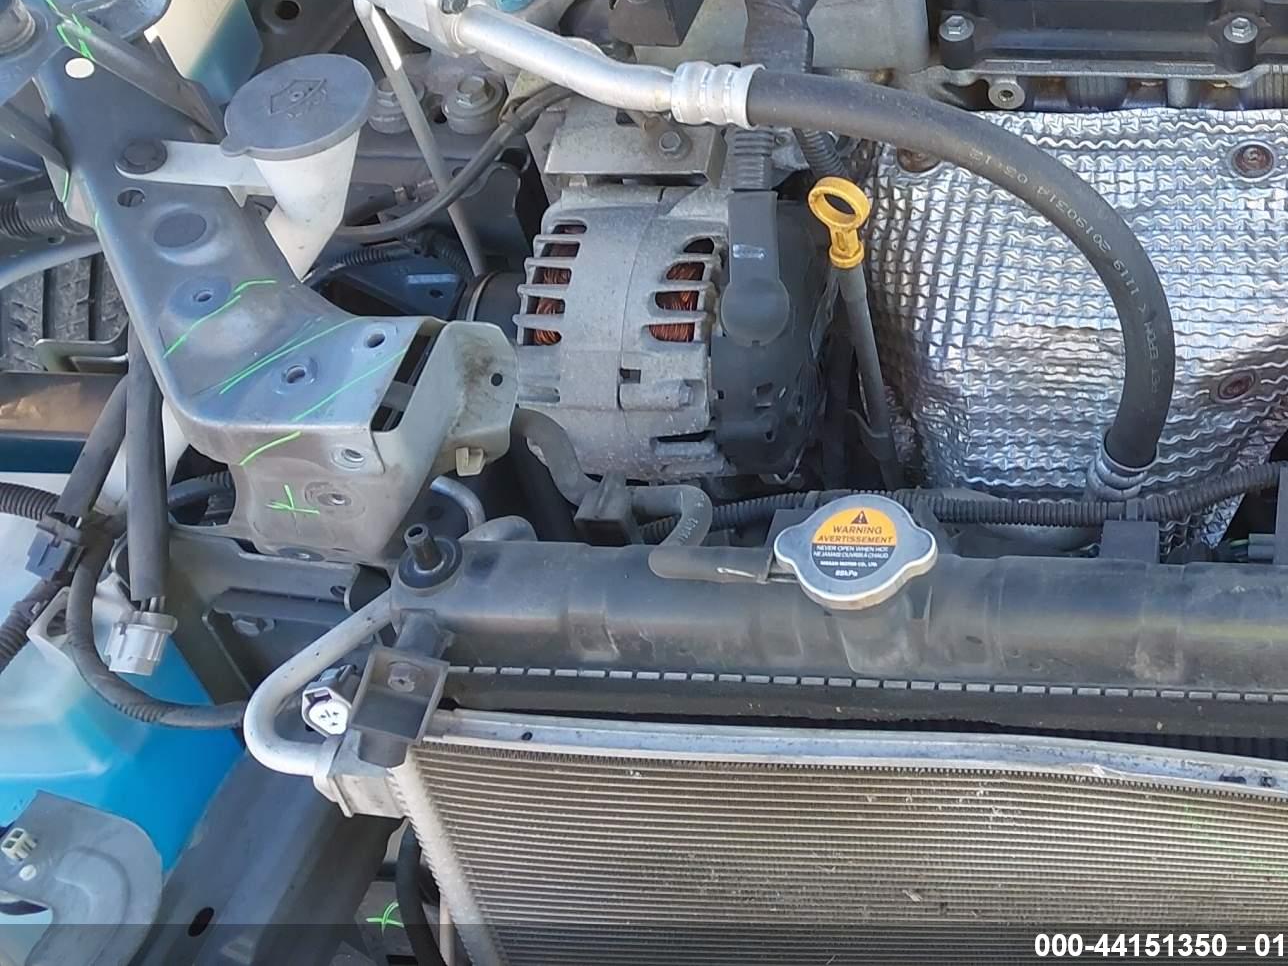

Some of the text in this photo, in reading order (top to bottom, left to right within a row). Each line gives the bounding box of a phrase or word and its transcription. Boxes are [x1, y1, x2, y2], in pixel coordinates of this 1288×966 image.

[1035, 184, 1113, 254] 20190314
[833, 526, 882, 534] WARNING
[818, 535, 893, 543] AVERTISSEMENT
